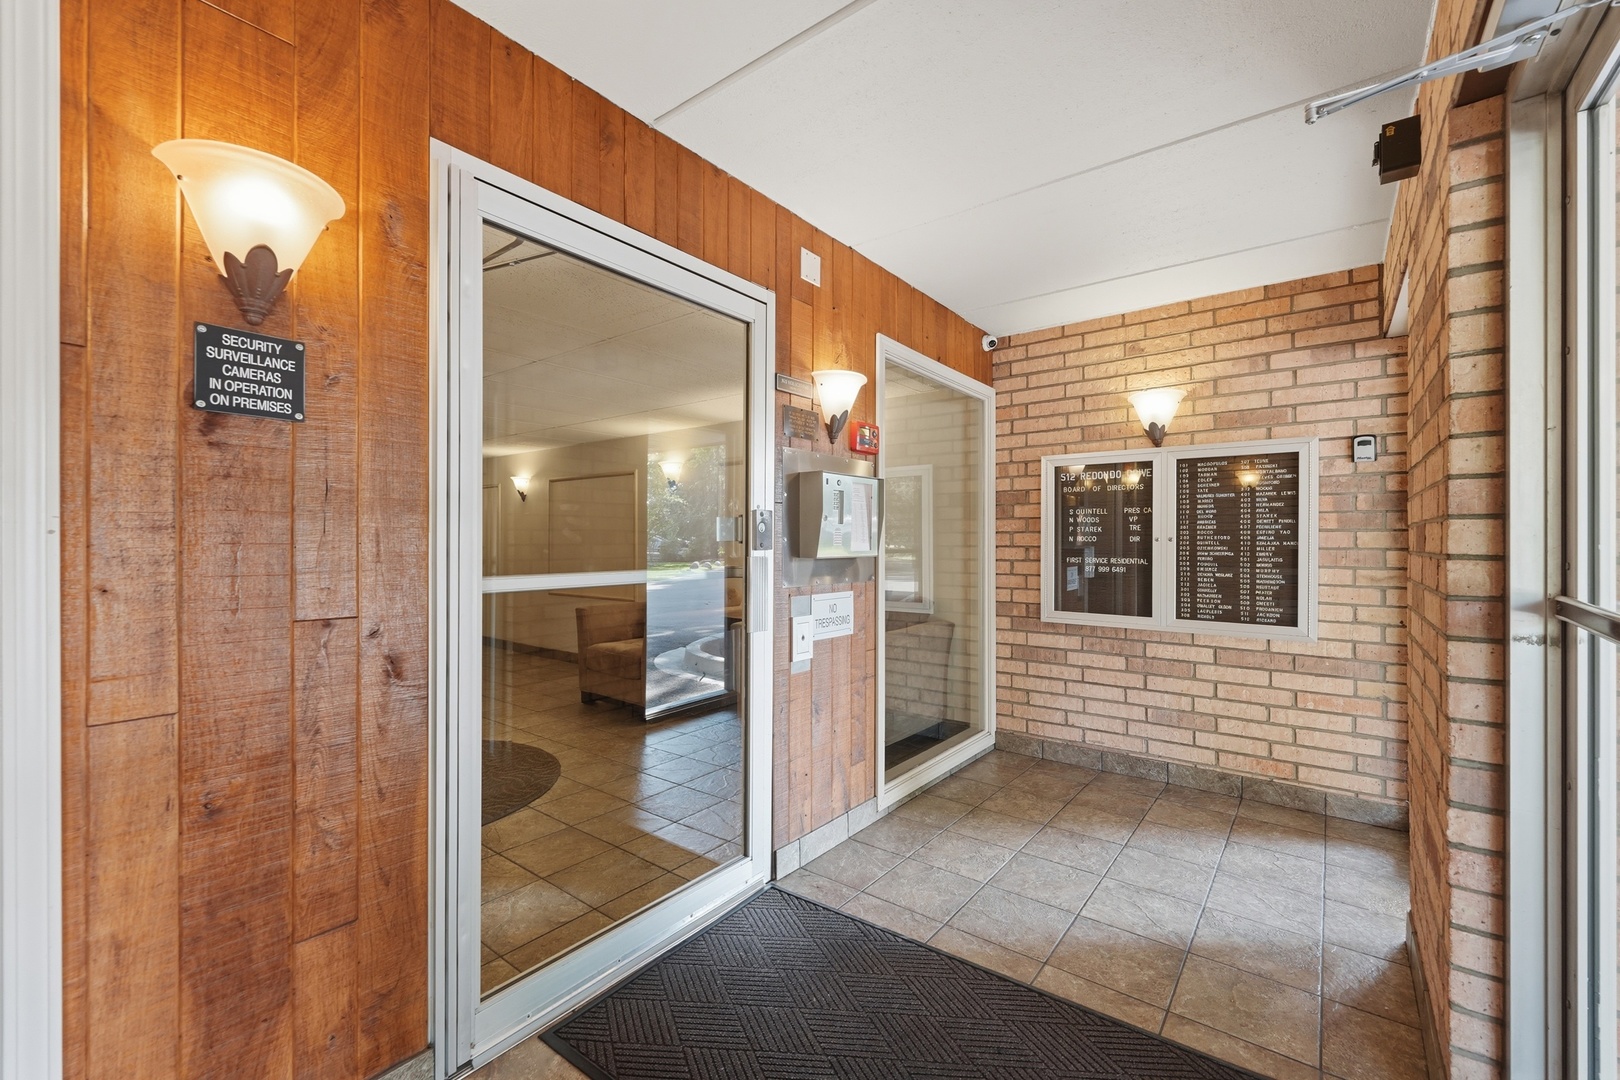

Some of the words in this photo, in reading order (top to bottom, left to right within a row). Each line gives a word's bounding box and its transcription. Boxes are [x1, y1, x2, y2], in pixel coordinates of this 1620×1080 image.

[222, 334, 282, 354] SECURITY
[206, 346, 296, 372] SURVEILLANCE
[222, 364, 282, 384] CAMERAS
[209, 377, 222, 390] IN
[224, 380, 293, 400] OPERATION
[210, 393, 230, 406] ON
[232, 396, 292, 414] PREMISES
[1080, 470, 1122, 481] REDONDO
[1107, 483, 1144, 491] DIRECTORS
[829, 603, 837, 613] NO
[815, 614, 850, 629] TRESPASSING
